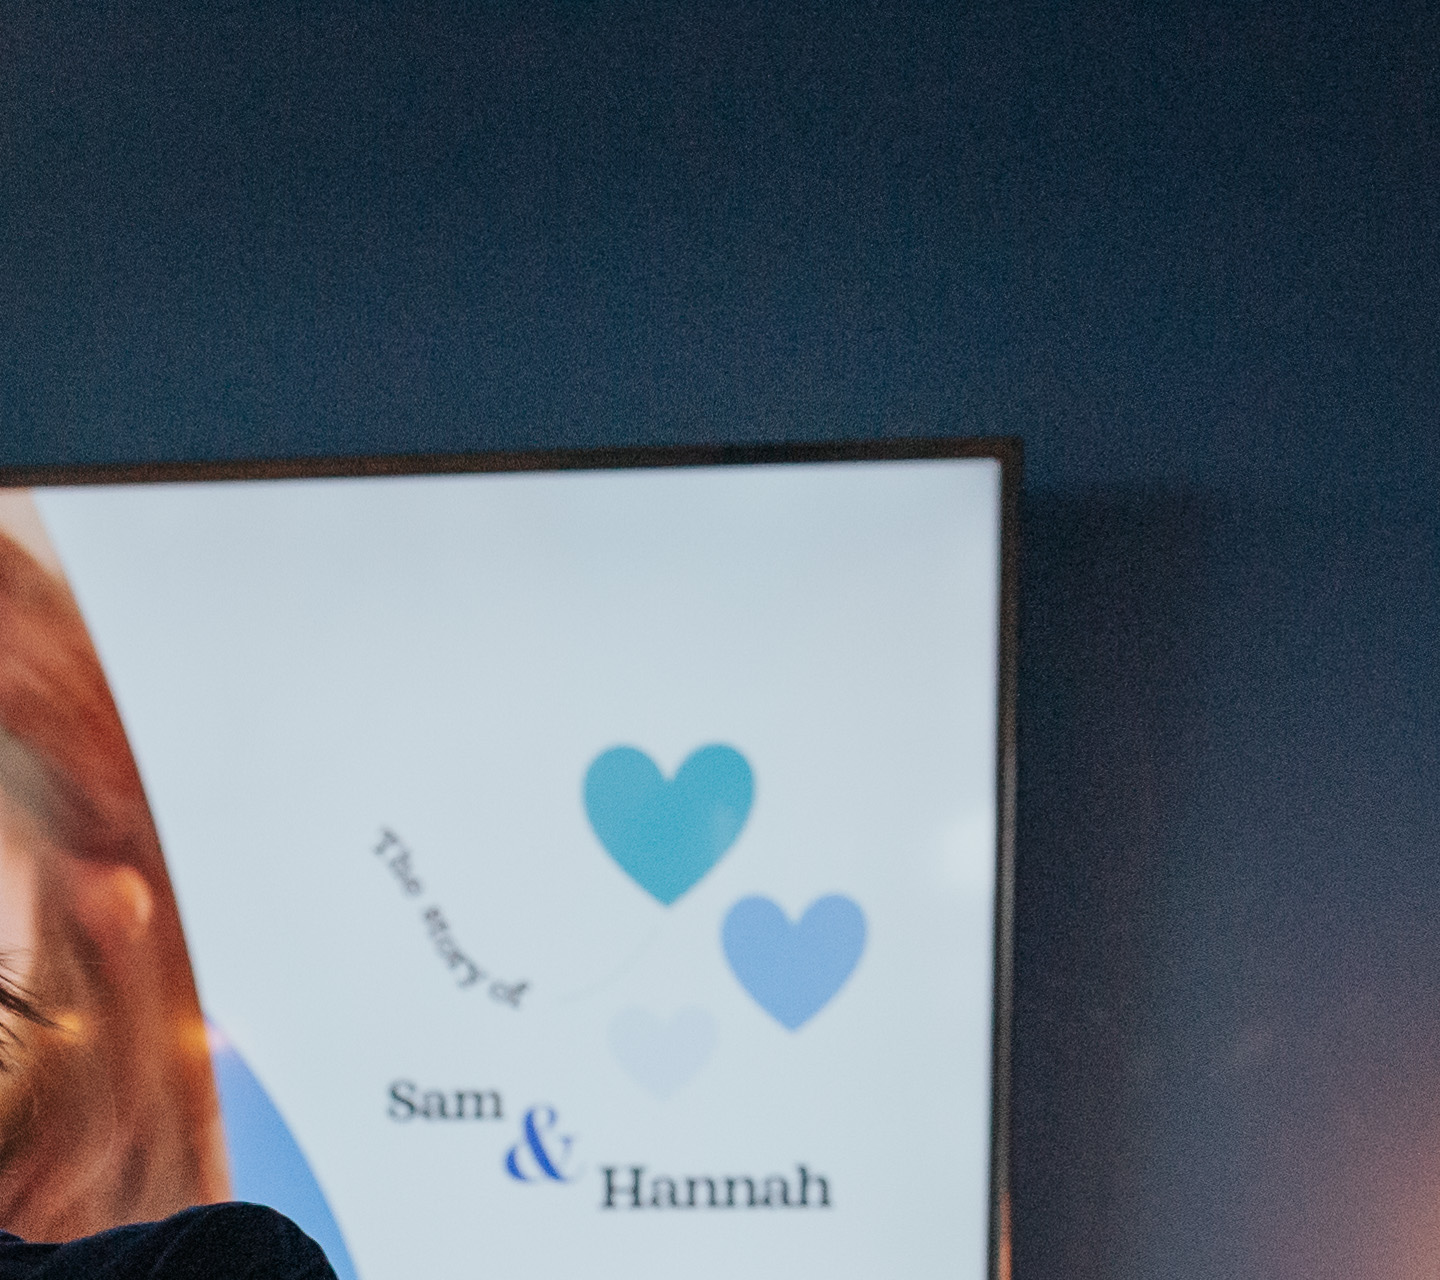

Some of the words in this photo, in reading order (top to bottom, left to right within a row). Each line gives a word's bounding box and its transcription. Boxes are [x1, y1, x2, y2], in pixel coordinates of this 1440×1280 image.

[374, 827, 422, 897] The
[423, 906, 485, 988] story
[489, 979, 530, 1008] of
[386, 1080, 504, 1122] Sam
[502, 1105, 576, 1184] &
[600, 1164, 833, 1211] Hannah
